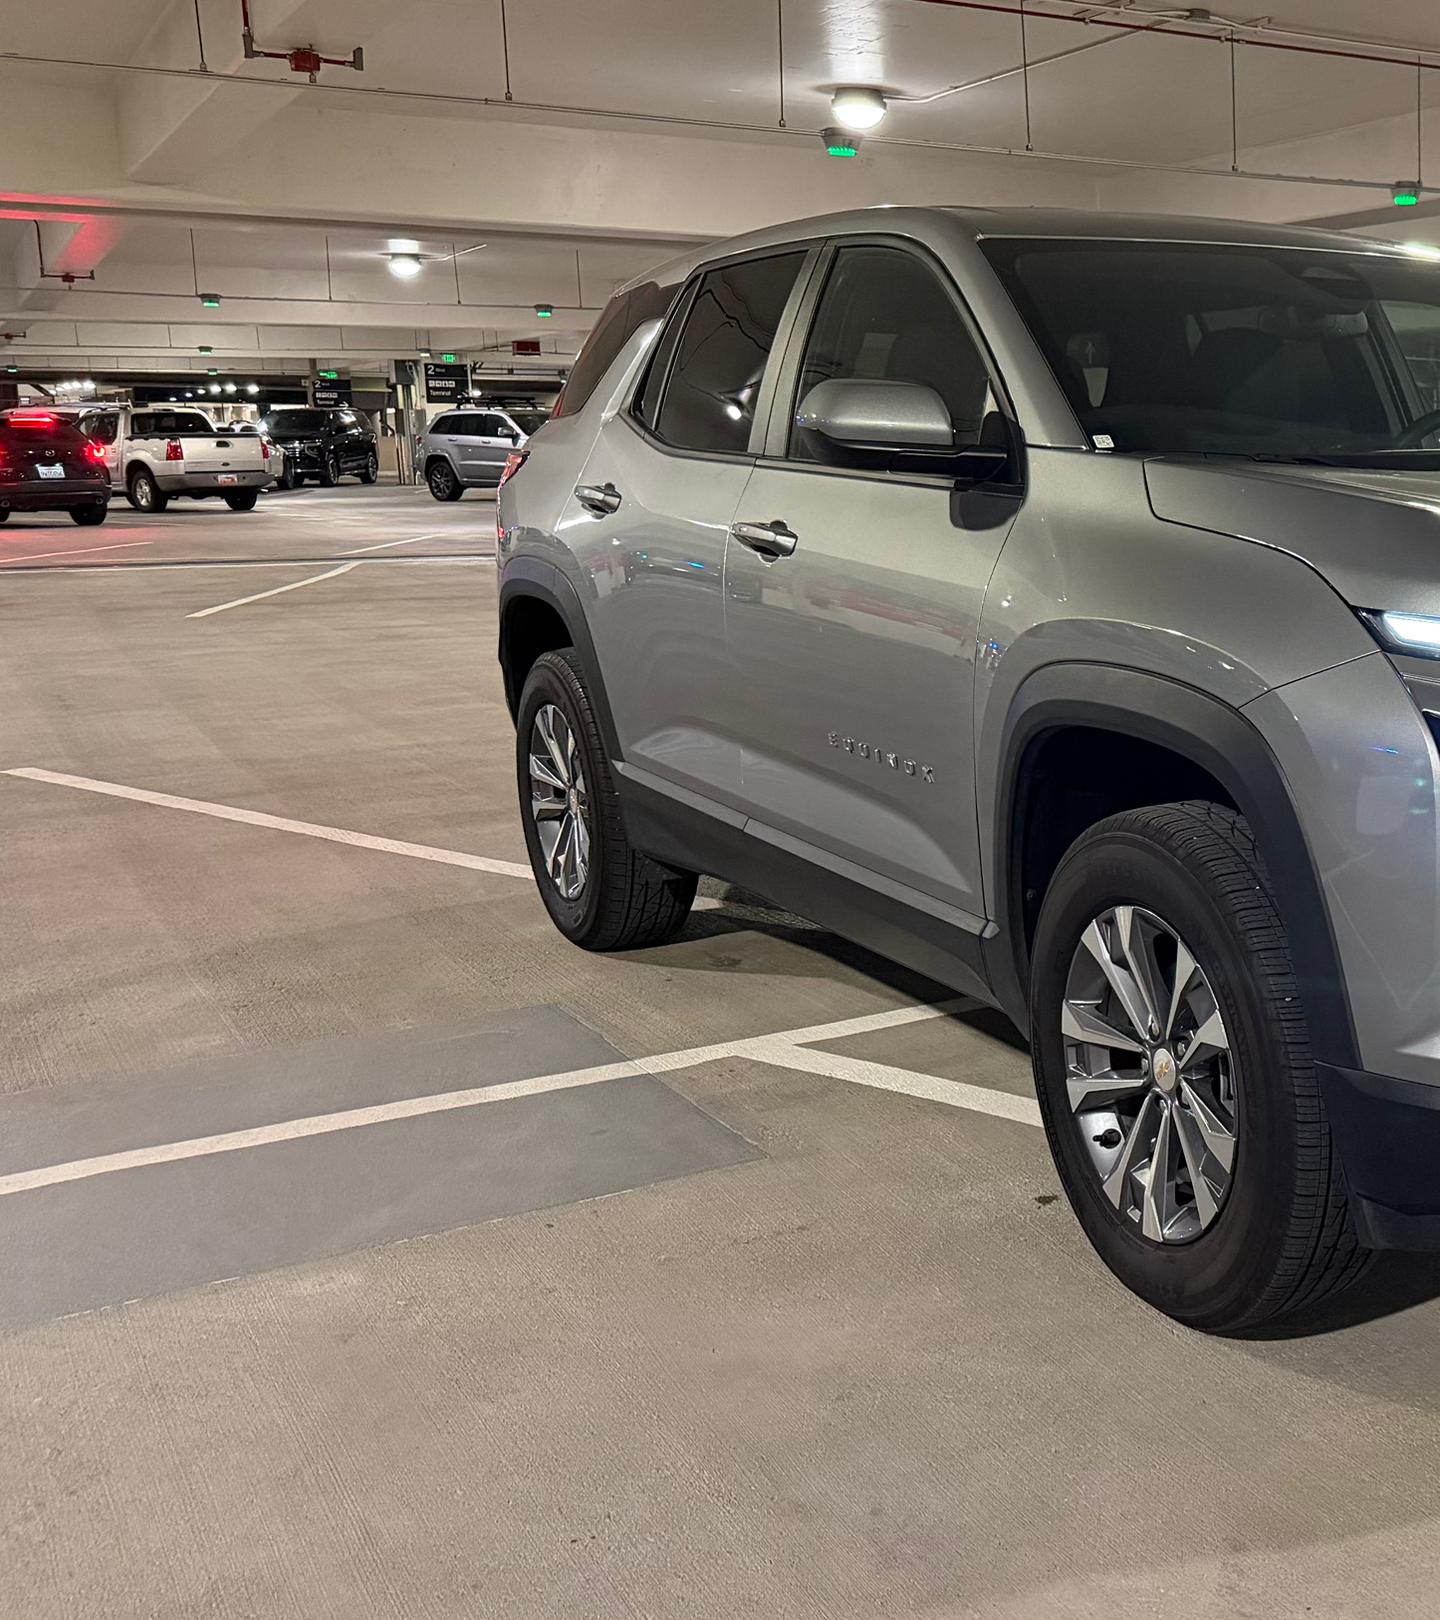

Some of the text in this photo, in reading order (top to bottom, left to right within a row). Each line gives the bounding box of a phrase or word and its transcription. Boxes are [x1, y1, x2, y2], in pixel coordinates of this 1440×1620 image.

[427, 365, 435, 375] 2
[314, 380, 321, 388] 2
[827, 730, 936, 784] EQUINOX
